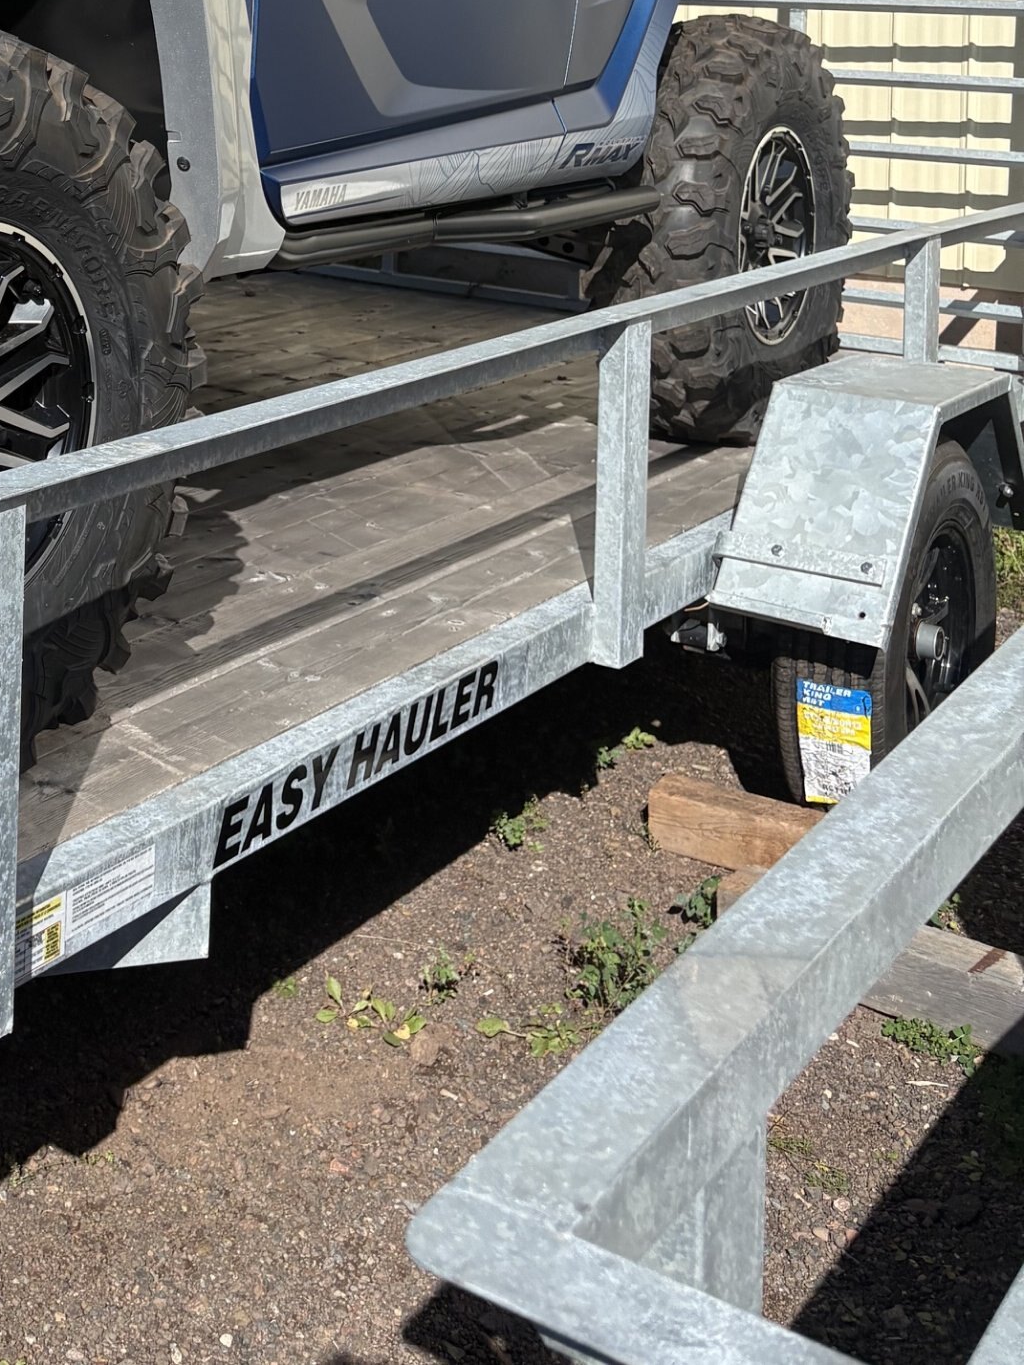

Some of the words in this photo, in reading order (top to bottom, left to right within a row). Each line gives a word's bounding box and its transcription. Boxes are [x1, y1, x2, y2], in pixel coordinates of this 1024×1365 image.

[294, 184, 348, 212] YAMAHA
[802, 680, 852, 698] TRAILER
[803, 688, 832, 701] KING
[212, 744, 341, 870] EASY
[345, 660, 499, 791] HAULER
